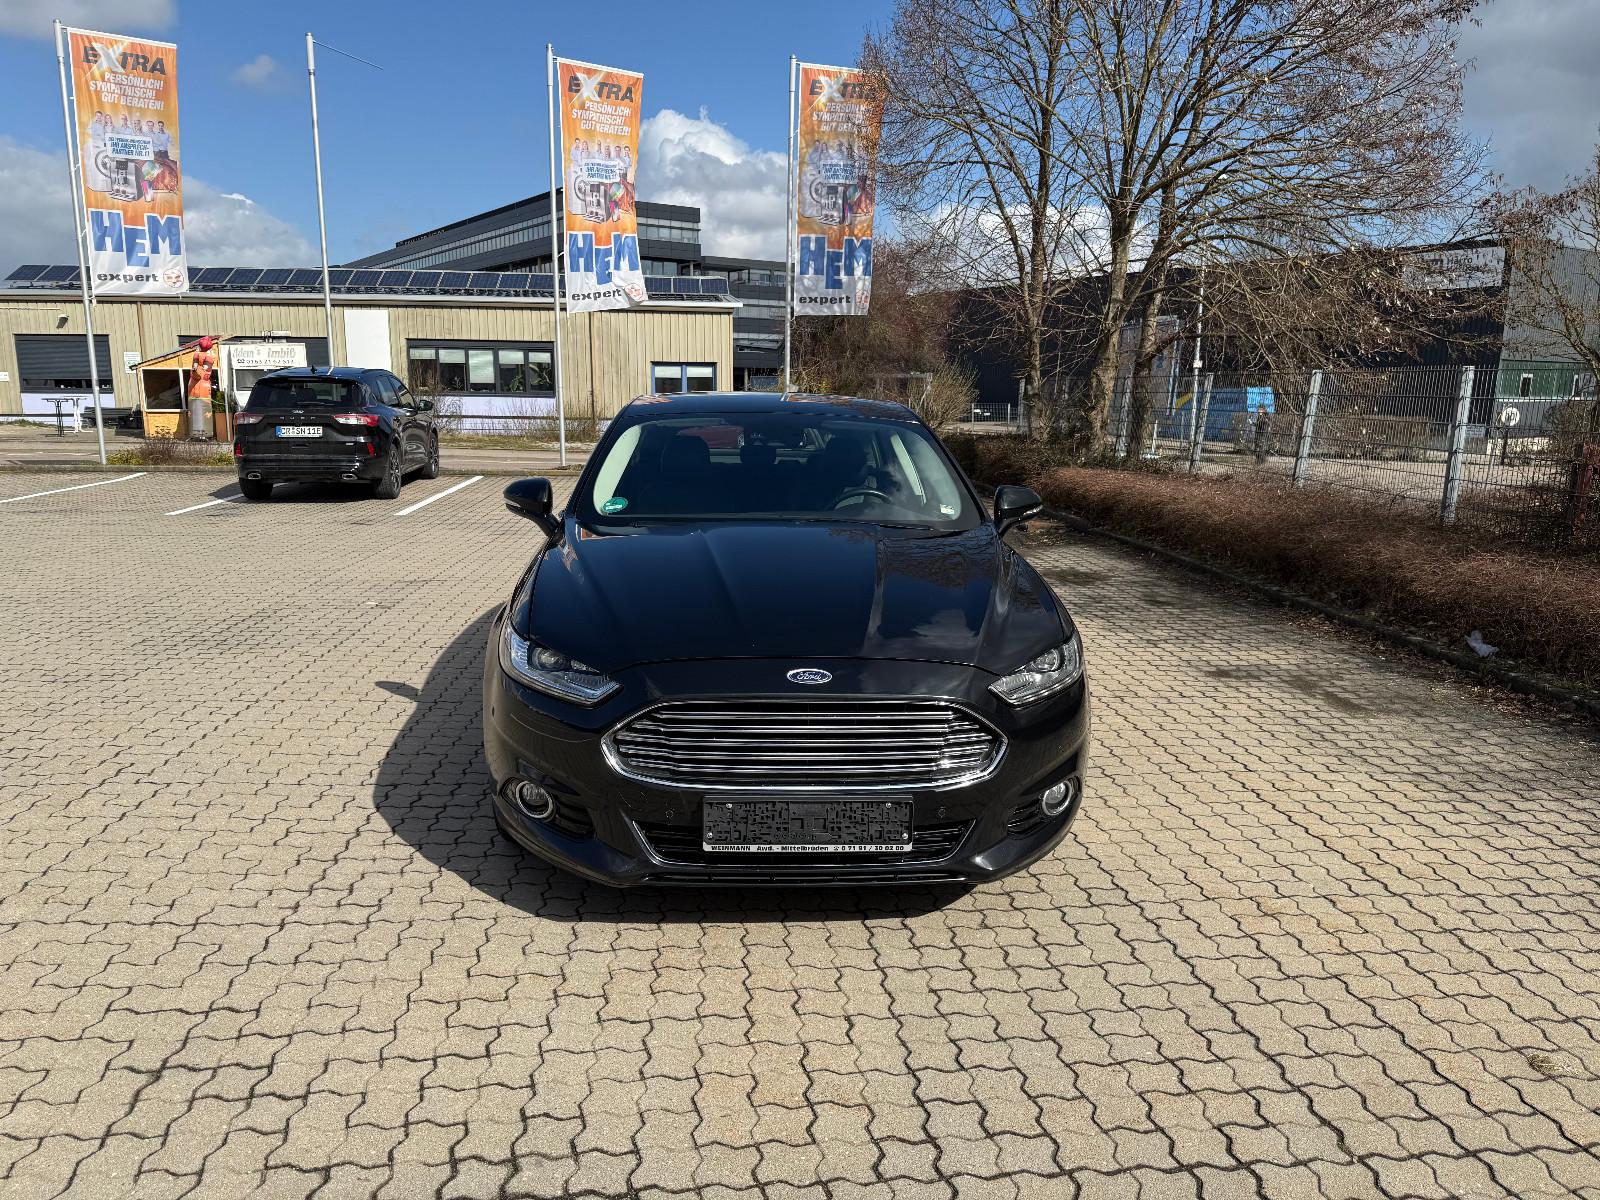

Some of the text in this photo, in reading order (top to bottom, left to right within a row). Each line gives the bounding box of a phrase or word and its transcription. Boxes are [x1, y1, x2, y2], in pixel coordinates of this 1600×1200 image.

[82, 42, 166, 75] EXTRA
[89, 80, 156, 99] SYMPATHISCH!
[104, 72, 164, 90] PERSÖNLICH!
[568, 73, 633, 103] EXTRA
[101, 92, 164, 110] GUT BERATEN!
[585, 101, 631, 117] PERSÖNLICH!
[580, 120, 595, 131] GUT
[821, 122, 836, 131] GUT
[90, 210, 182, 268] HEM
[569, 233, 640, 285] HEM
[800, 236, 872, 289] HEM
[97, 273, 159, 283] expert
[571, 288, 622, 301] expert
[799, 295, 851, 305] expert
